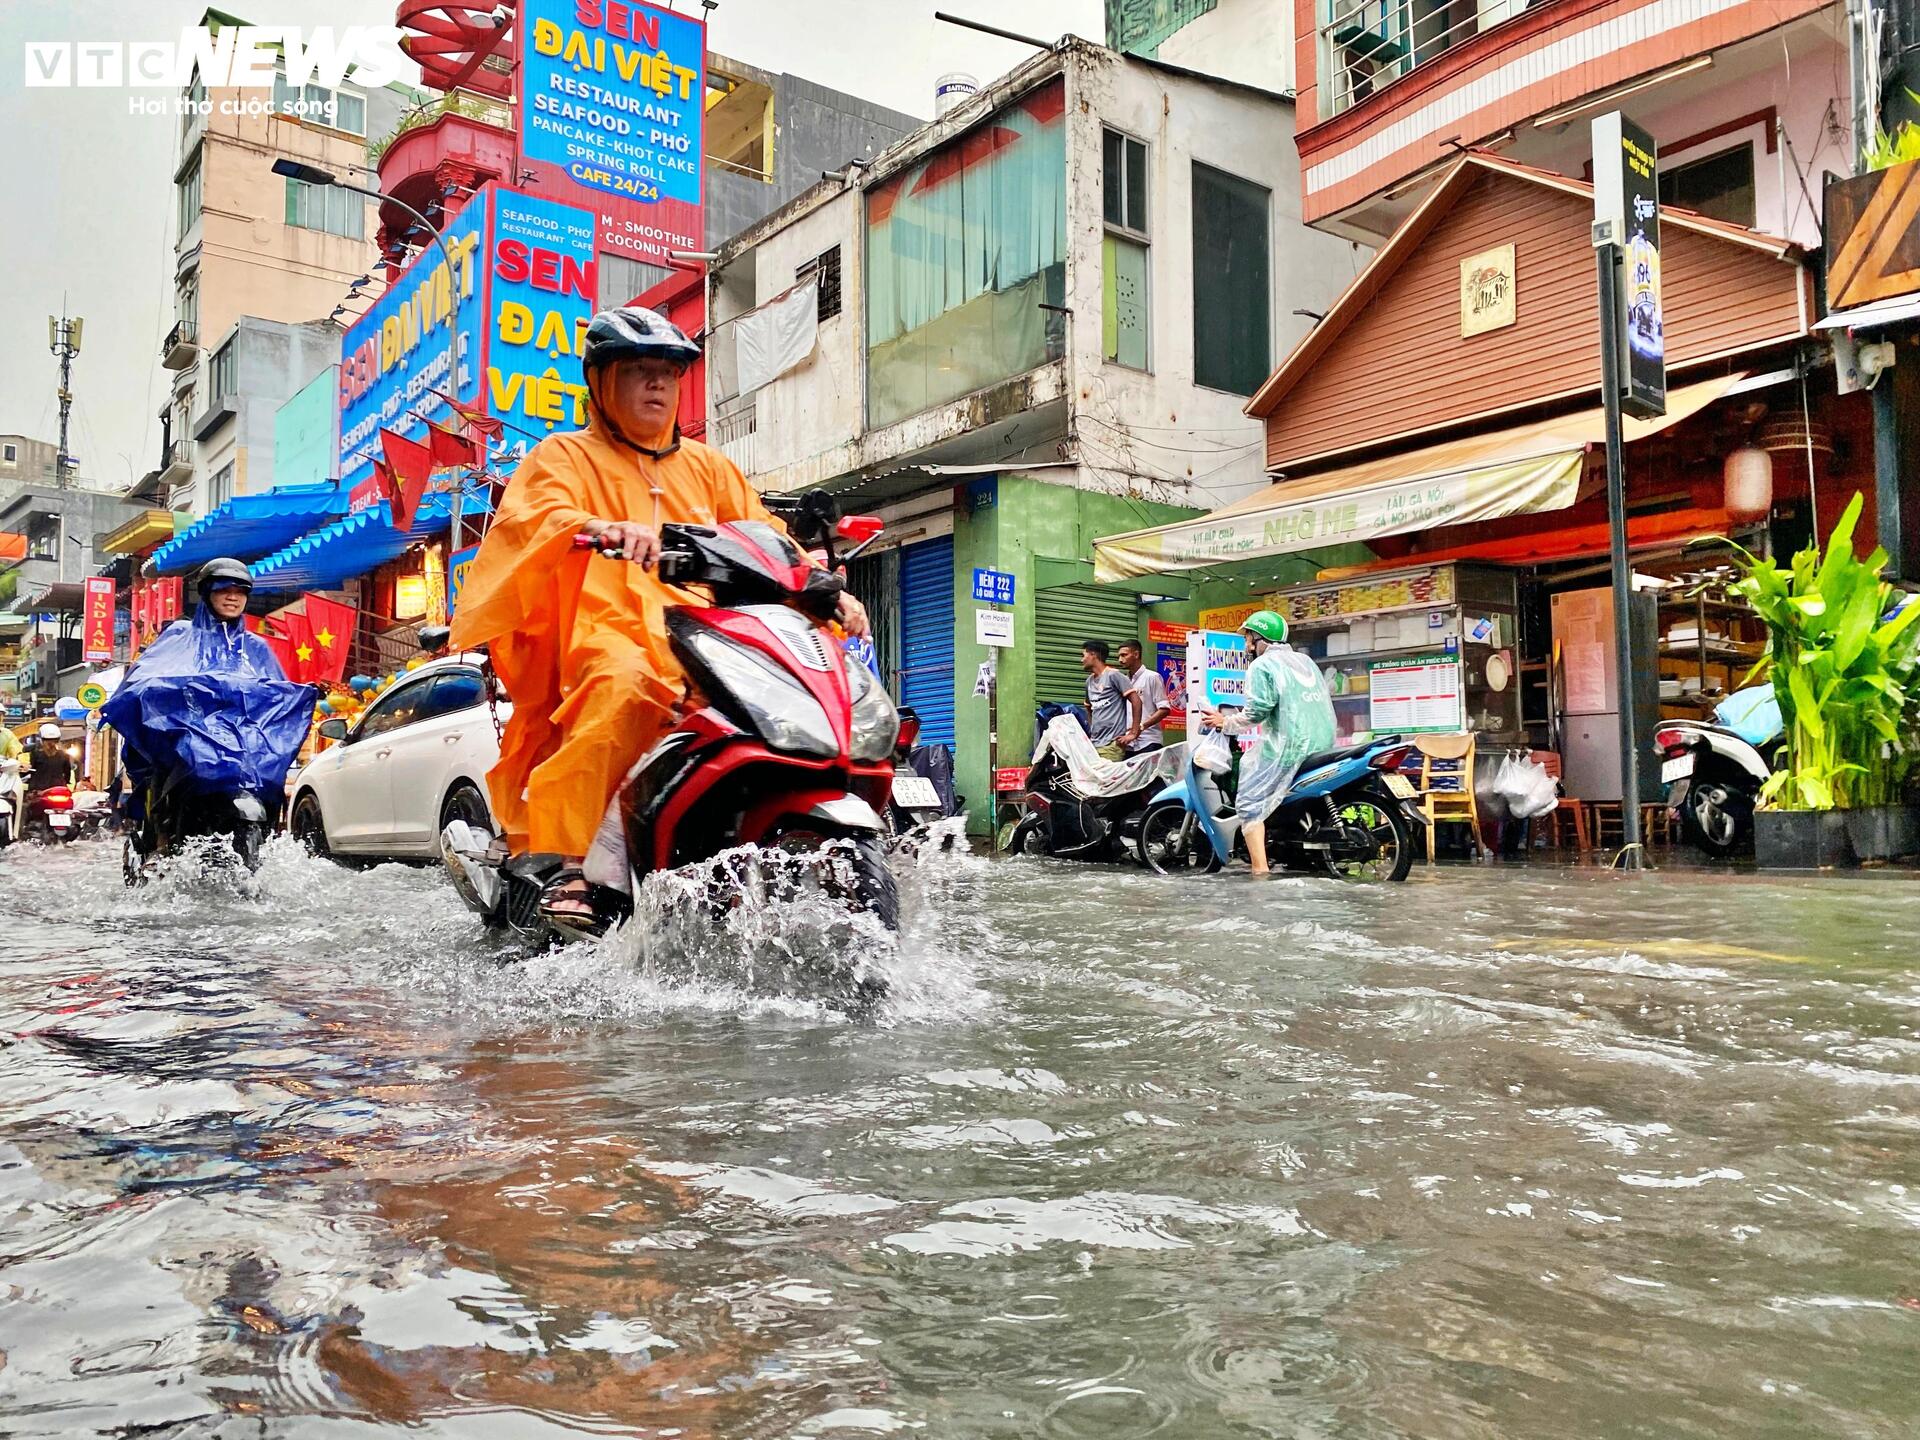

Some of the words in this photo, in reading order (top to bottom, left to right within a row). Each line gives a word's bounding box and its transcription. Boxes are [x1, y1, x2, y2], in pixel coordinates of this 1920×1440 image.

[576, 0, 660, 49] SEN
[533, 17, 606, 73] ĐẠI
[612, 43, 697, 100] VIỆT
[534, 93, 631, 136] SEAFOOD
[650, 128, 692, 152] PHỞ
[550, 73, 681, 127] RESTAURANT
[532, 115, 655, 161] PANCAKE-KHOT
[657, 153, 696, 175] CAKE
[566, 143, 625, 171] SPRING
[629, 161, 667, 183] ROLL
[571, 164, 611, 187] CAFE
[614, 175, 659, 200] 24/24
[502, 208, 559, 231] SEAFOOD
[502, 222, 565, 244] RESTAURANT
[571, 239, 593, 252] CAFE
[606, 231, 669, 257] COCONUT
[625, 221, 695, 249] SMOOTHIE
[495, 238, 594, 301] SEN
[340, 330, 382, 409] SEN
[487, 367, 589, 429] VIỆT
[997, 577, 1010, 591] 222
[93, 593, 107, 647] INDIAN
[1253, 619, 1269, 631] Grab
